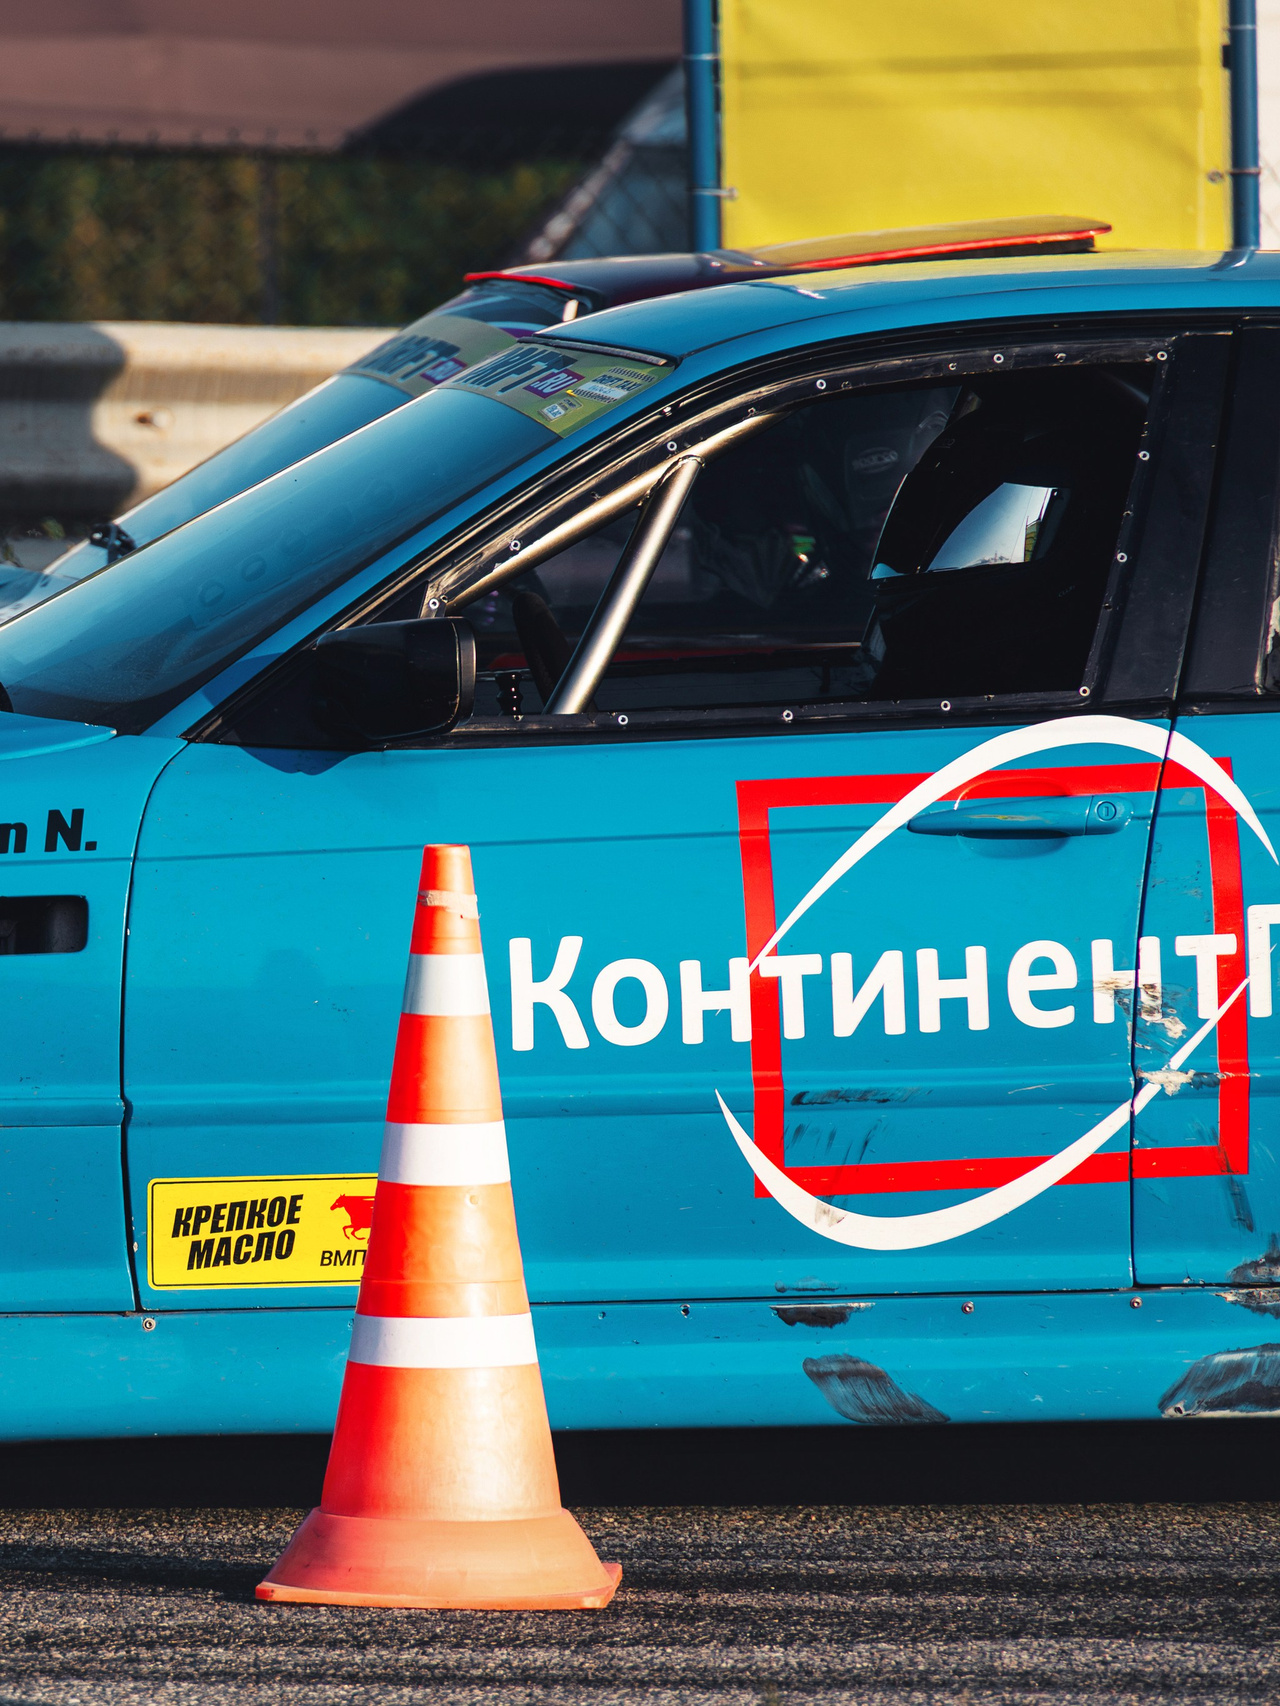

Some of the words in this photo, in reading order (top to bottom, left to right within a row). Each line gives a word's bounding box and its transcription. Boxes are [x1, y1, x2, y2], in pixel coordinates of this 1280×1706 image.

[44, 808, 98, 852] N.
[171, 1194, 304, 1238] КРЕПКОЕ
[187, 1229, 296, 1270] МАСЛО
